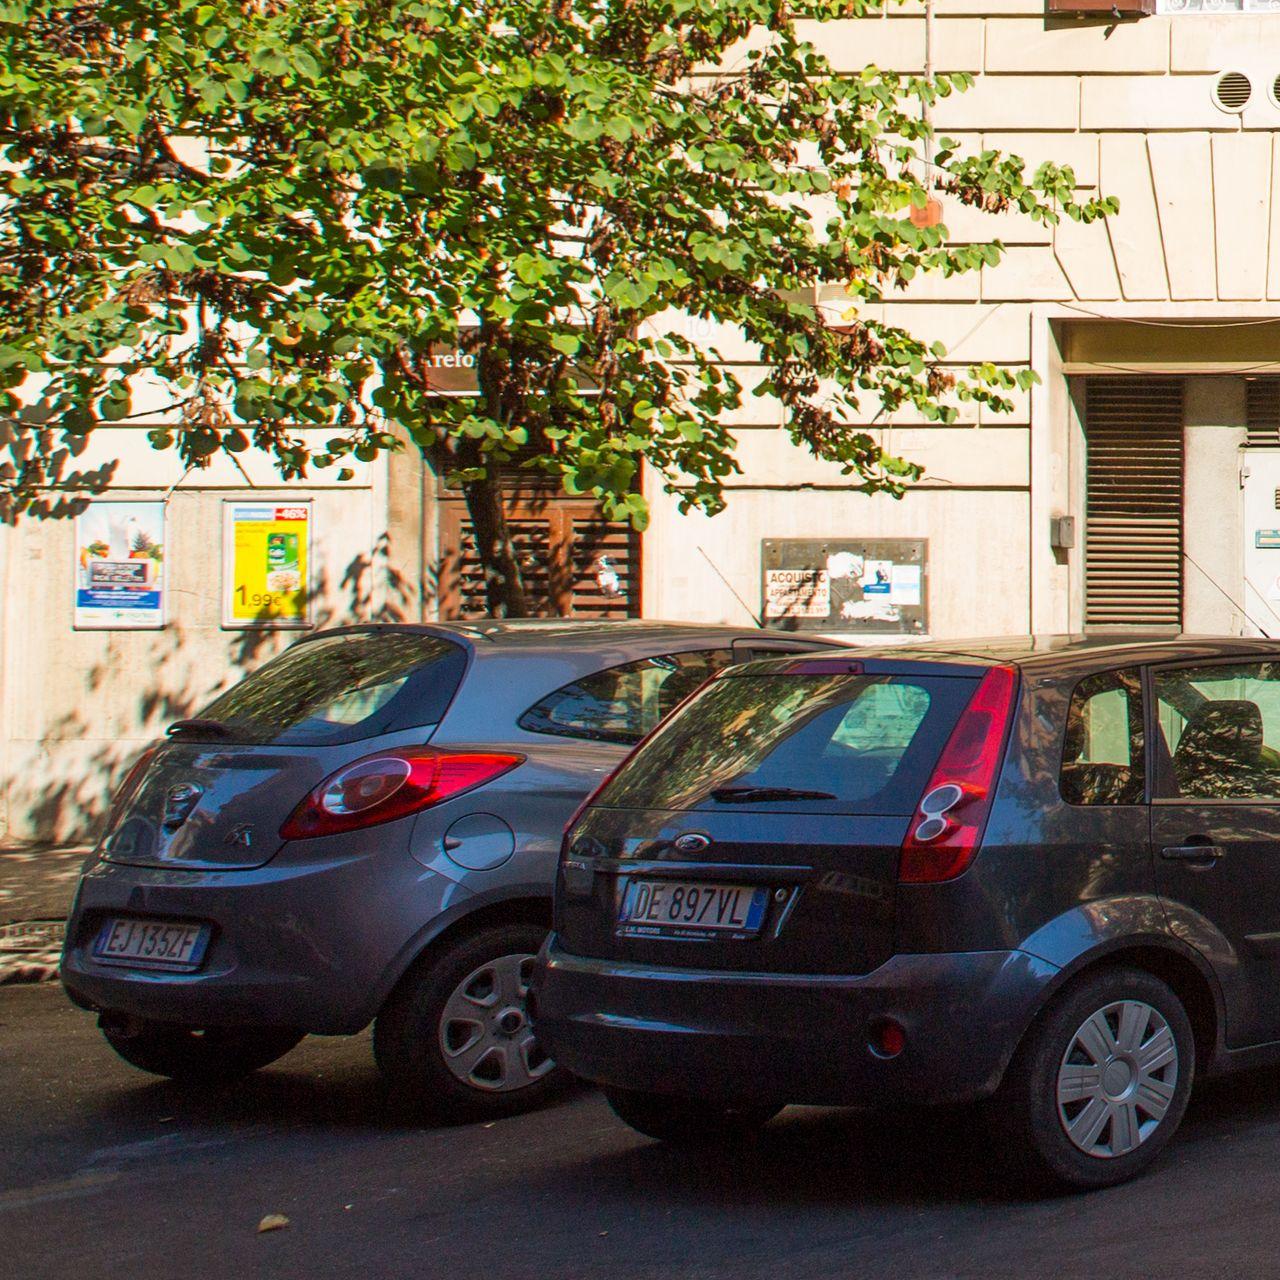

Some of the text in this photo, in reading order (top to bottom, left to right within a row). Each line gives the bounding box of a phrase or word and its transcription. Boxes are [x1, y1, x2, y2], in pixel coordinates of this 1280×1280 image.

[275, 507, 307, 520] -46%
[632, 883, 744, 925] DE 897VL
